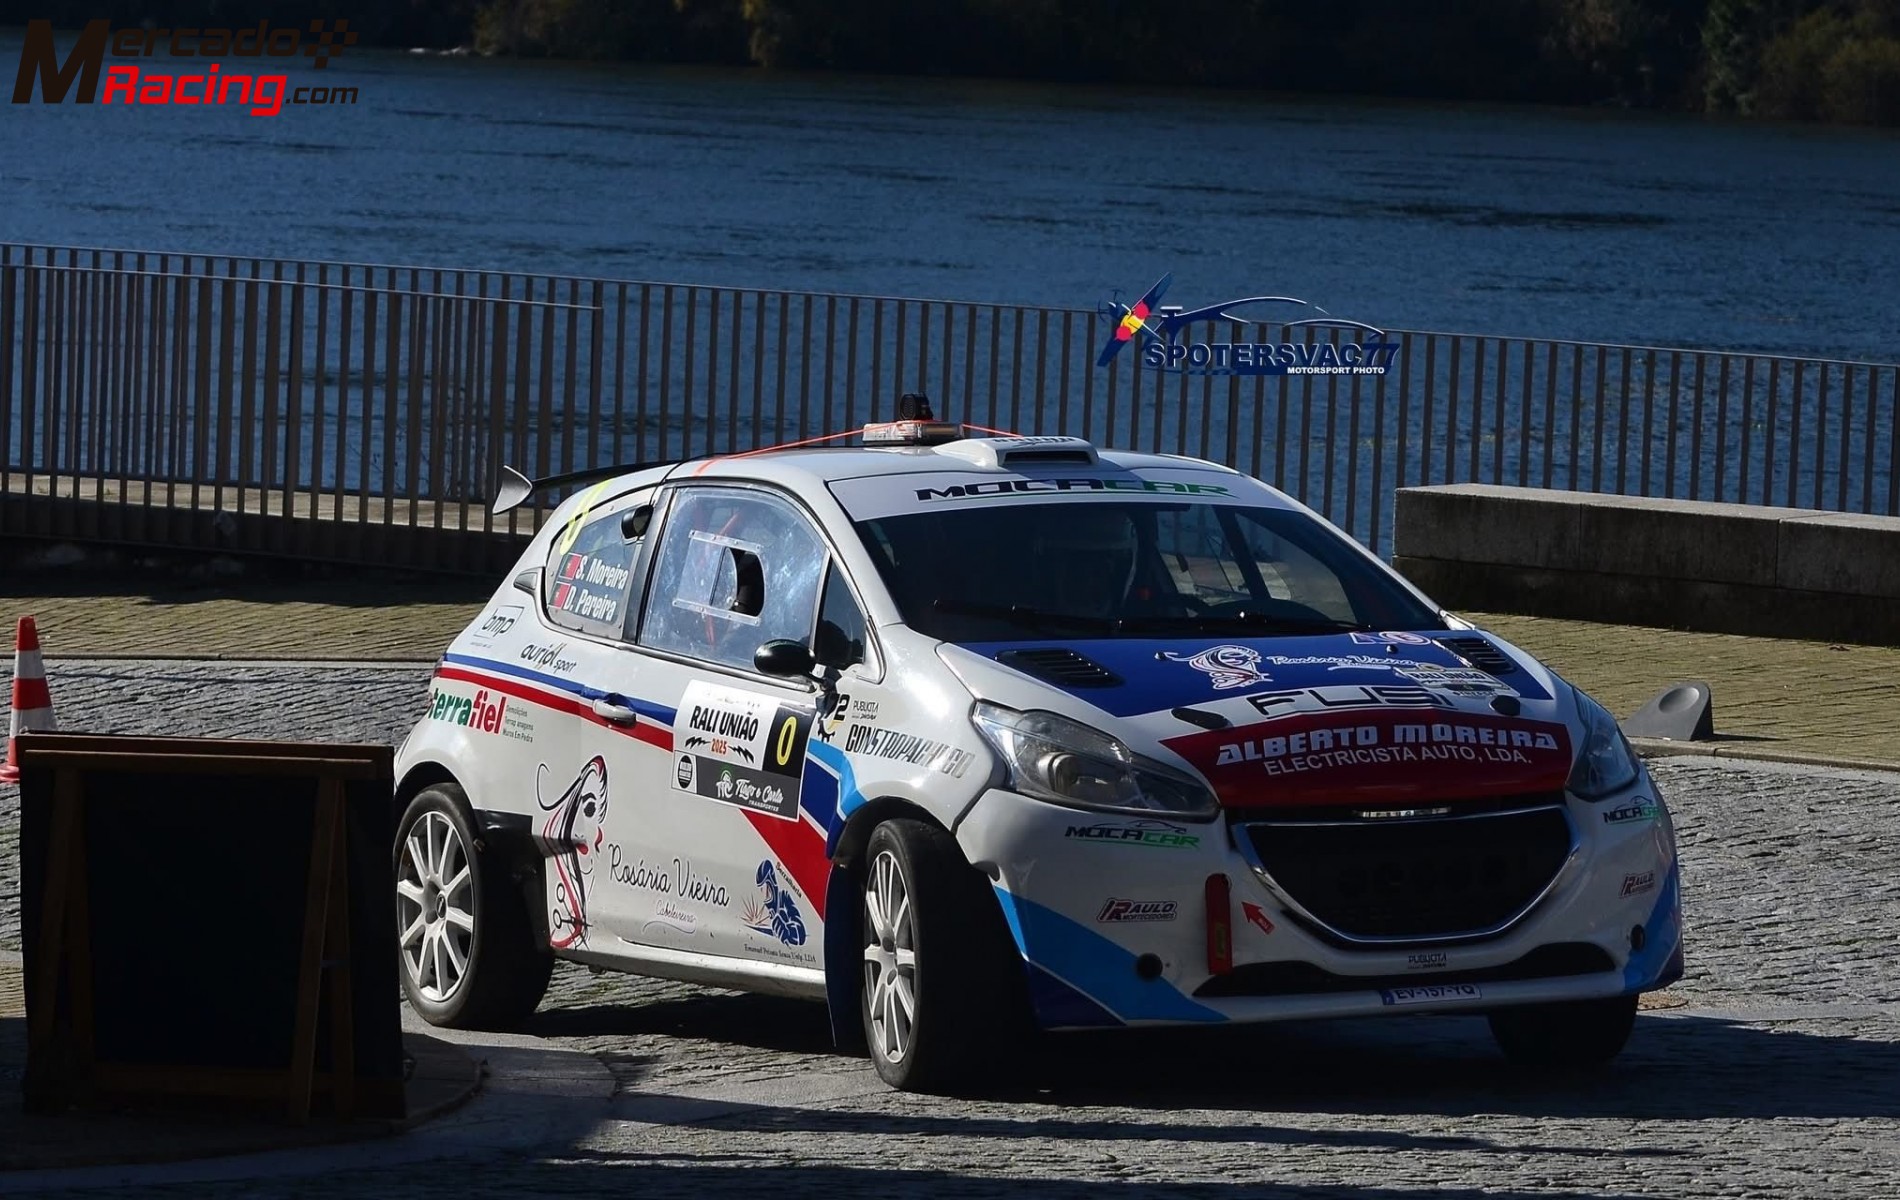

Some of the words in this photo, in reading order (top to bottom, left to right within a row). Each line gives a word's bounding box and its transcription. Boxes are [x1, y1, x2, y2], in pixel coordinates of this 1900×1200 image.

[914, 479, 1232, 501] MOCACAR
[575, 555, 588, 580] S.
[586, 558, 629, 590] Moreira
[563, 586, 577, 611] D.
[574, 588, 617, 621] Pereira
[553, 659, 577, 674] sport
[428, 687, 507, 734] terrafiel
[689, 705, 721, 733] RALI
[719, 711, 759, 742] UNIÃO
[711, 738, 728, 756] 2025
[776, 715, 798, 766] 0
[1215, 725, 1378, 766] ALBERTO
[1393, 724, 1559, 750] MOREIRA
[1263, 746, 1415, 776] ELECTRICISTA
[1421, 744, 1483, 763] AUTO,
[1487, 746, 1532, 763] LDA.
[1065, 825, 1200, 847] MOCACAR
[608, 844, 671, 893] Rosária
[673, 858, 730, 907] Vieira
